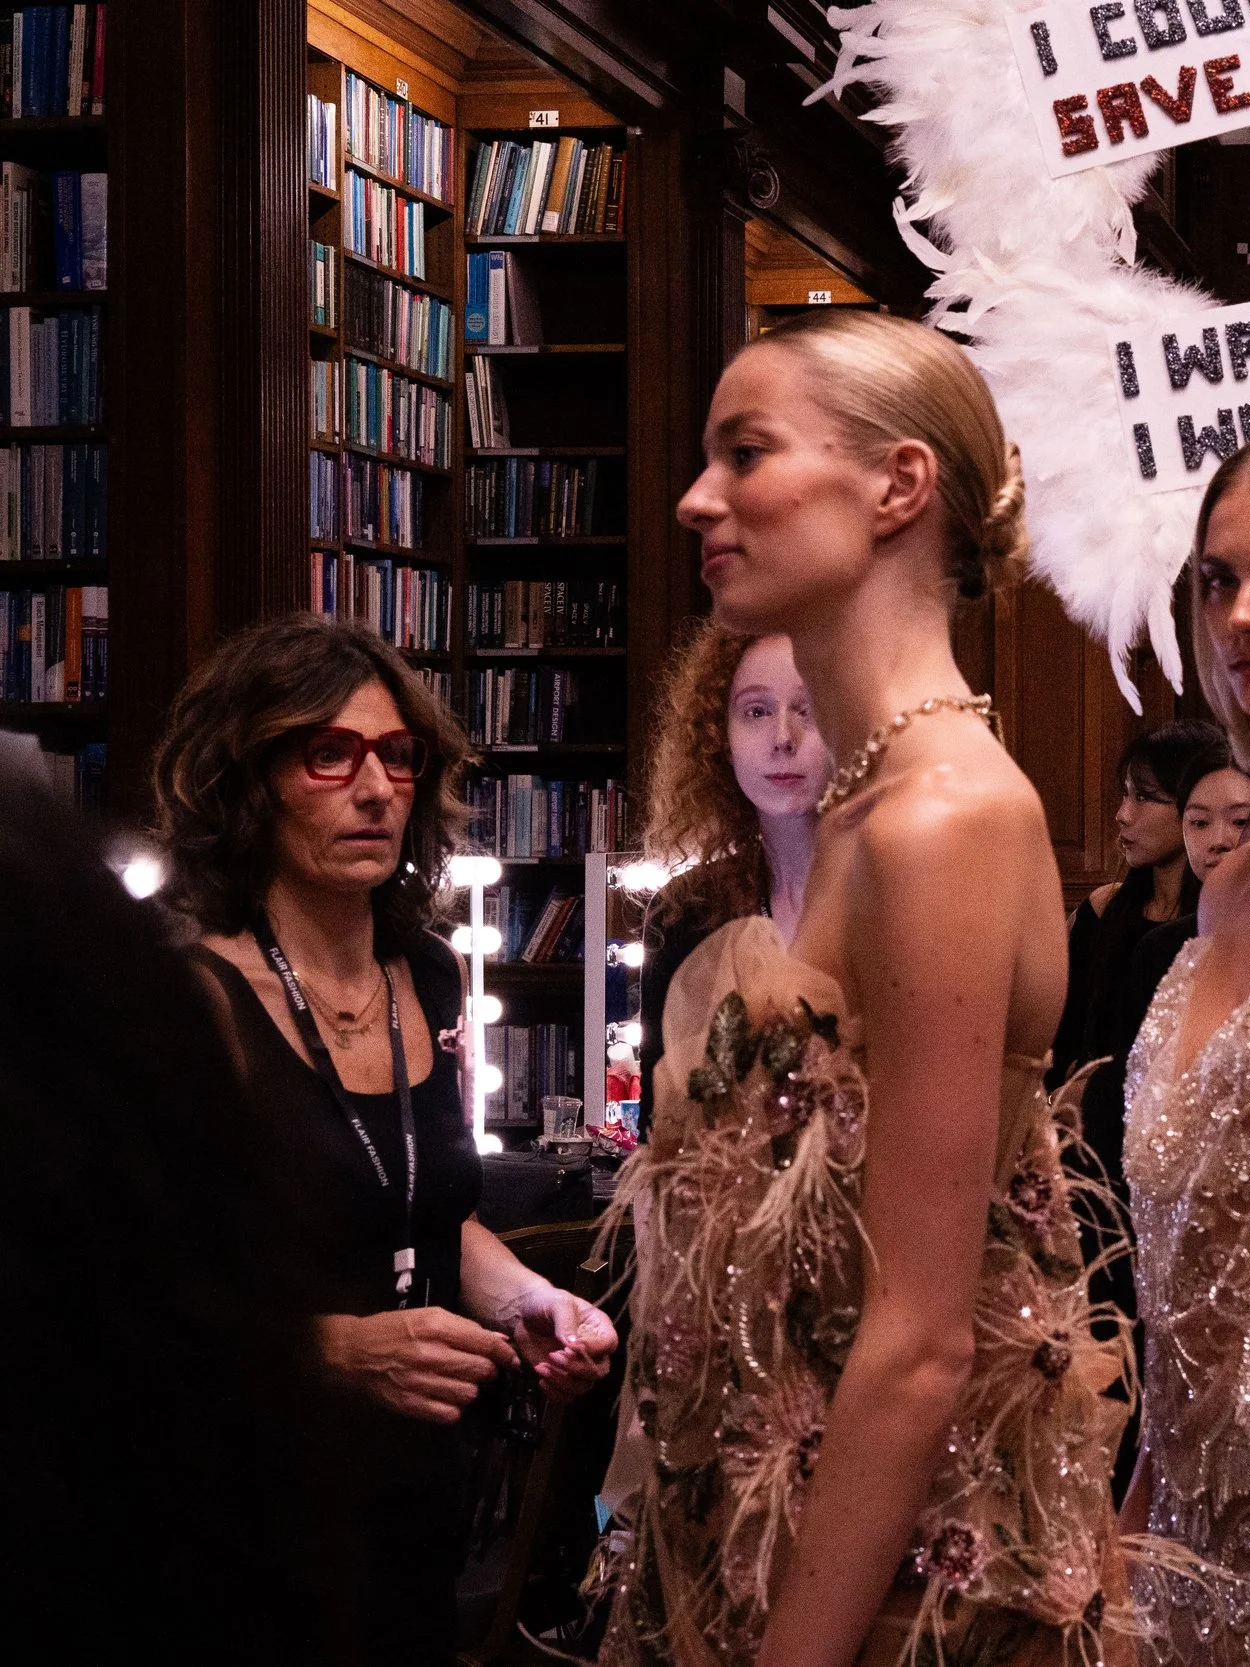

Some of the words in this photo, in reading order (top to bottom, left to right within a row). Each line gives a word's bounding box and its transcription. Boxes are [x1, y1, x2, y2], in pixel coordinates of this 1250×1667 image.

[1030, 20, 1058, 77] I
[536, 113, 549, 125] 41
[812, 292, 827, 303] 44
[1116, 341, 1140, 399] I
[1132, 422, 1157, 479] I
[544, 582, 552, 604] SPACE
[556, 582, 565, 604] SPACE
[553, 673, 561, 705] AIRPORT
[551, 707, 560, 736] DESIGN
[269, 947, 288, 971] FLAIR
[282, 971, 307, 1011] FASHION
[351, 1118, 371, 1145] FLAIR
[366, 1145, 390, 1187] FASHION
[405, 1133, 416, 1173] FASHION
